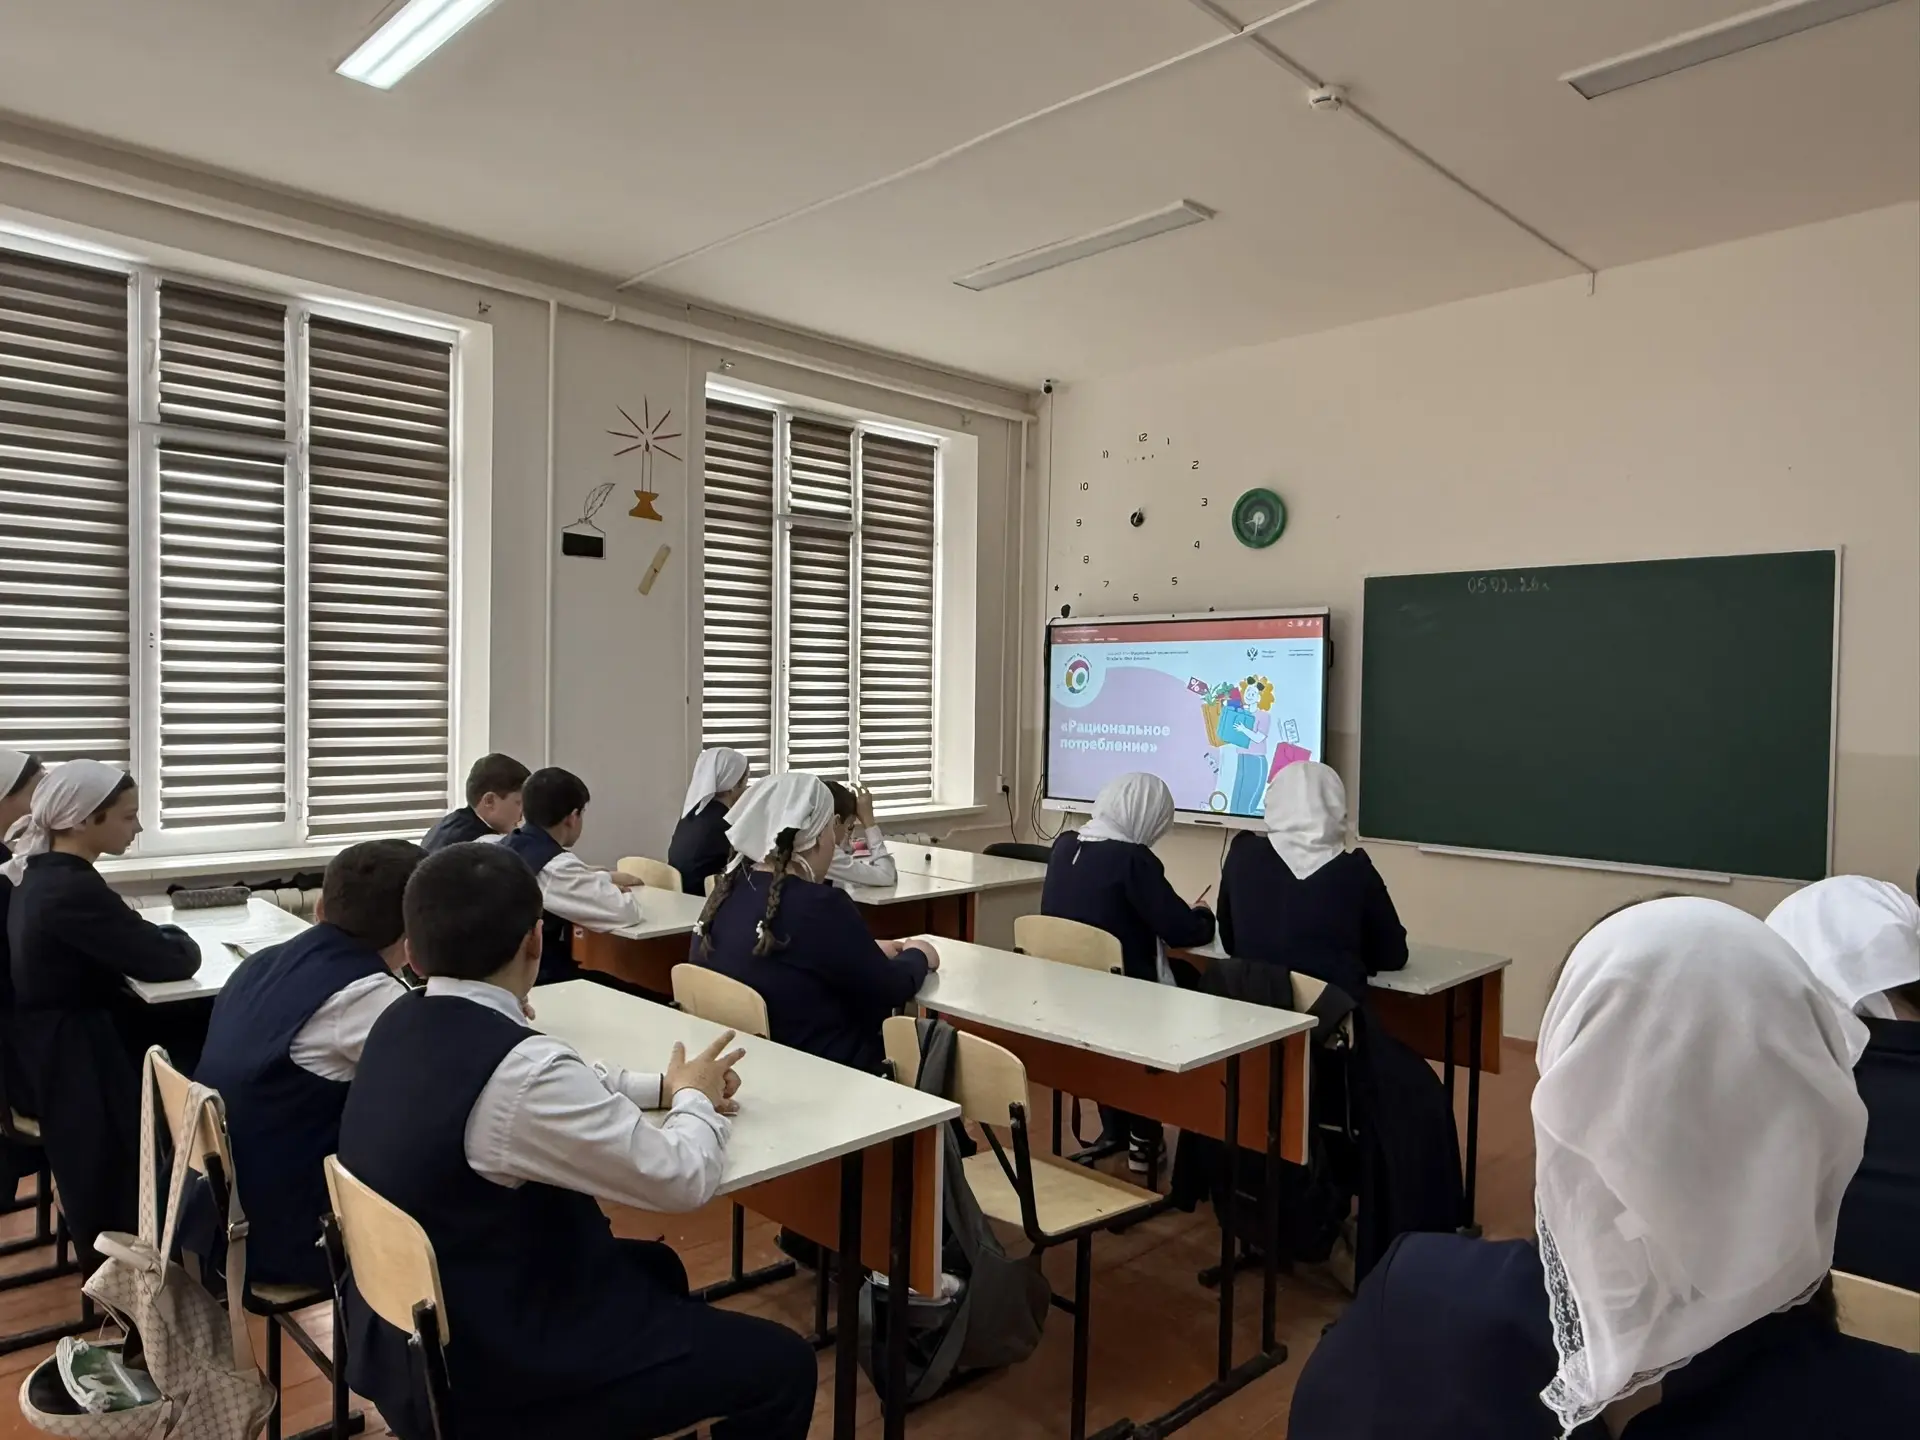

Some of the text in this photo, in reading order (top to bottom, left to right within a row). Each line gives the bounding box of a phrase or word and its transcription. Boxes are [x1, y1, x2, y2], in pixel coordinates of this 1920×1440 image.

[1138, 432, 1148, 442] 12
[1102, 449, 1110, 459] 11
[1191, 460, 1200, 470] 2
[1079, 481, 1089, 491] 10
[1201, 497, 1208, 507] 3
[1075, 518, 1082, 527] 9
[1194, 540, 1200, 549] 4
[1083, 555, 1090, 564] 8
[1171, 576, 1178, 586] 5
[1132, 593, 1139, 602] 6
[1060, 718, 1172, 737] «Рациональное
[1059, 737, 1158, 754] потребление»
